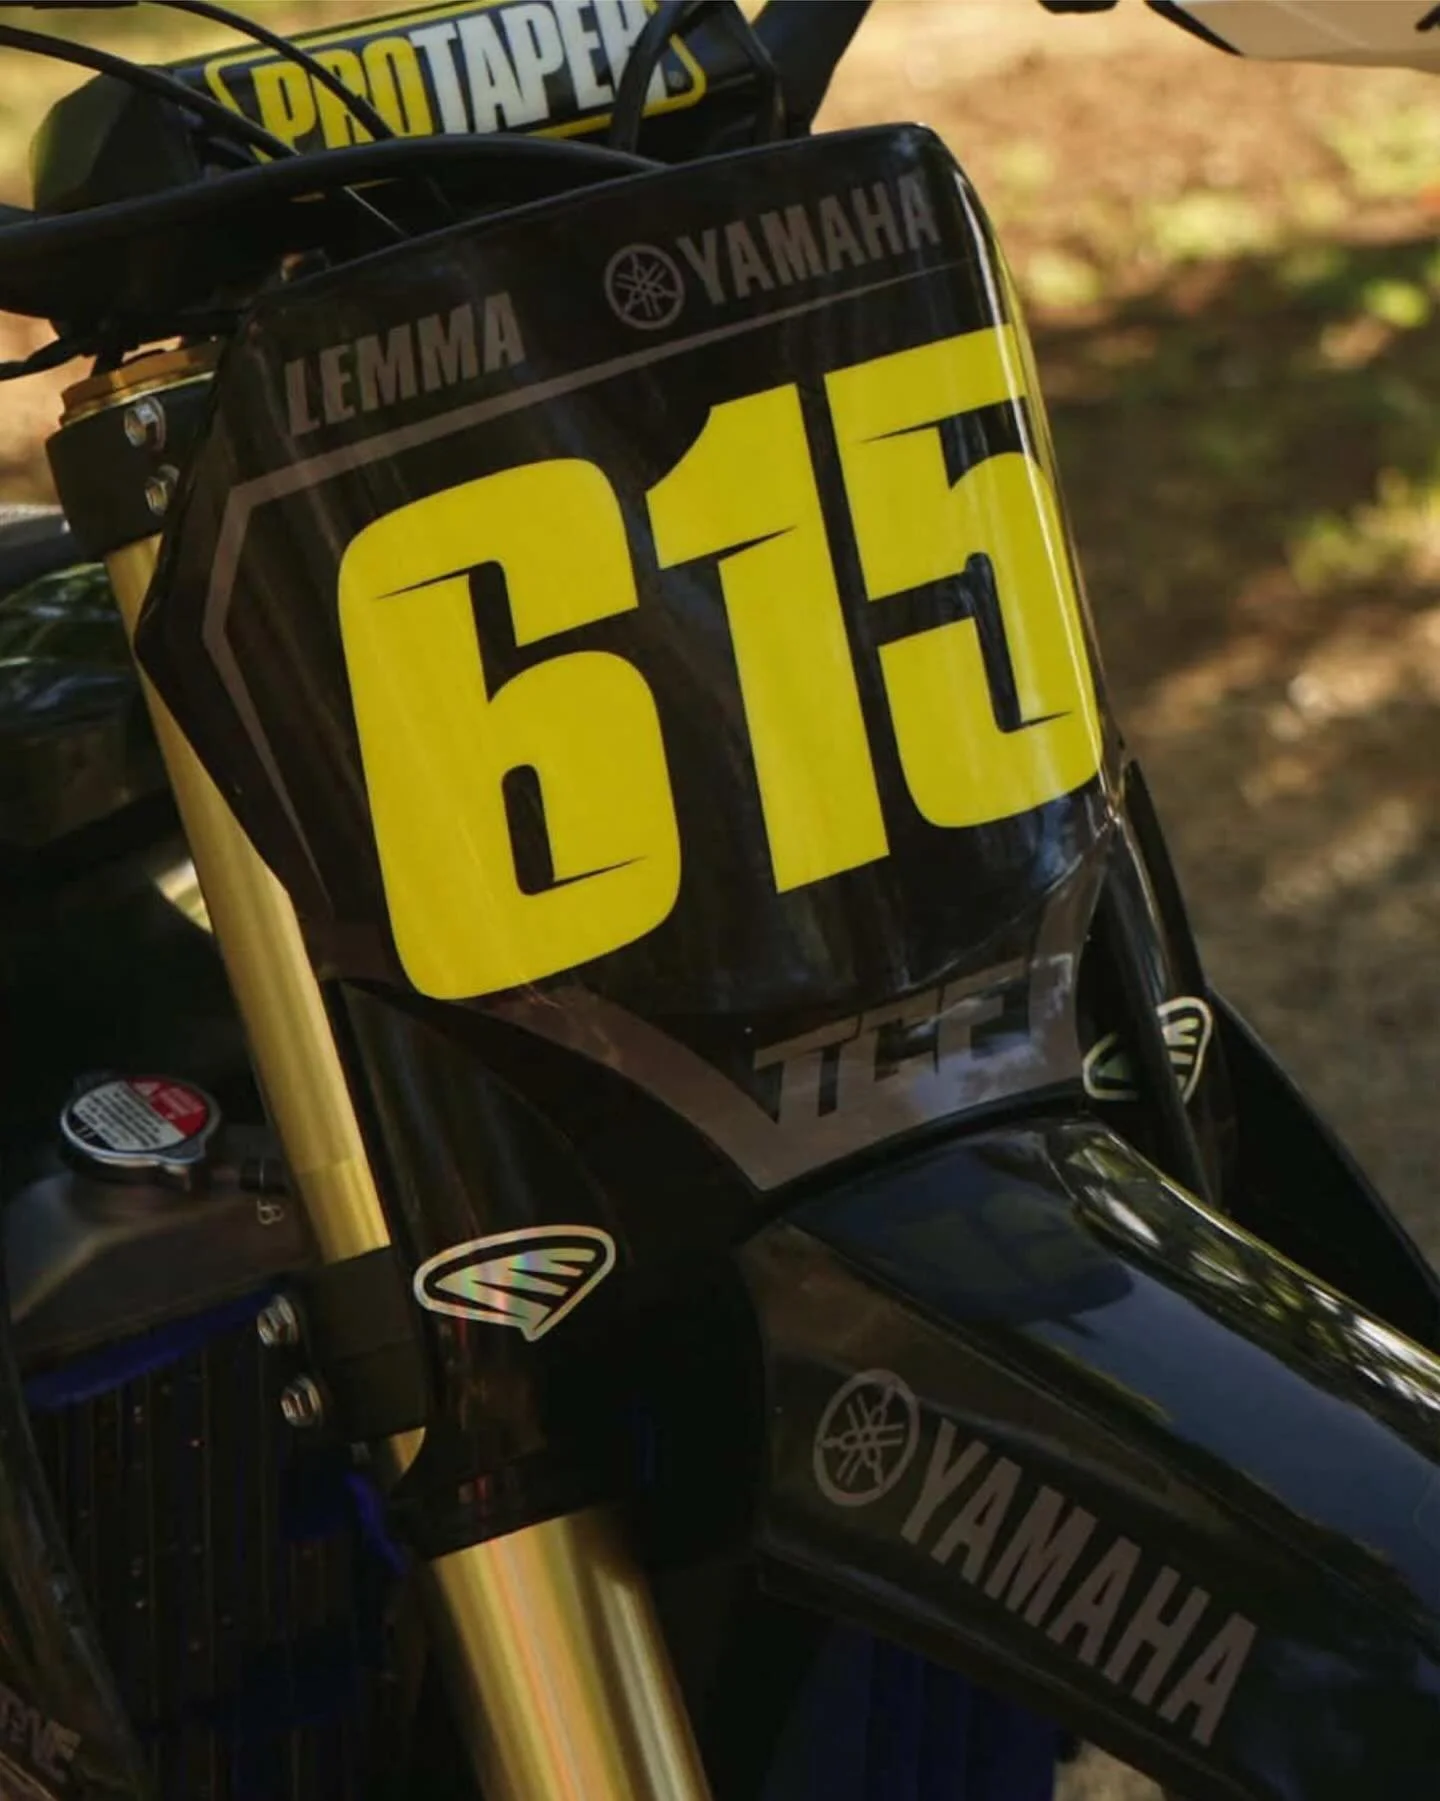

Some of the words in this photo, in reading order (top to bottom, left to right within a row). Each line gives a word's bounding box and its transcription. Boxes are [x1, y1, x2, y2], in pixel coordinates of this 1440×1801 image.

[678, 174, 942, 305] YAMAHA
[284, 292, 526, 437] LEMMA
[337, 323, 1103, 1001] 615
[901, 1417, 1257, 1747] YAMAHA
